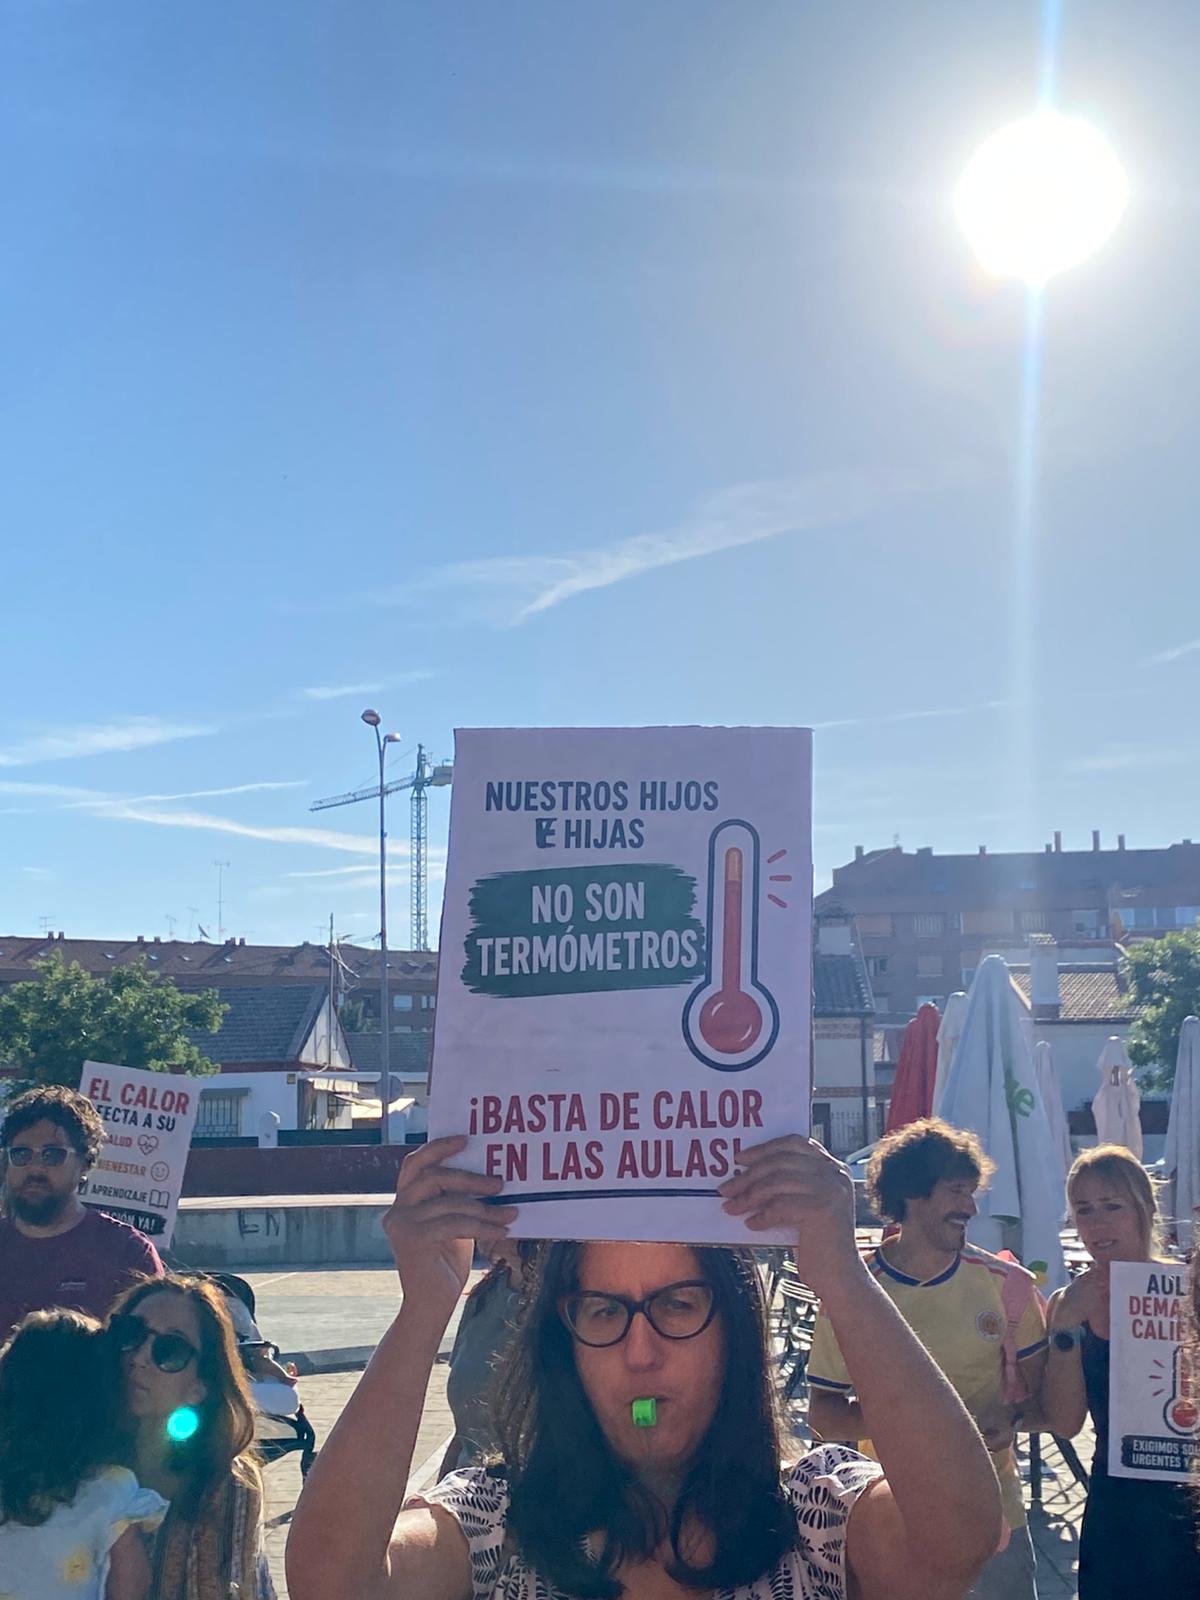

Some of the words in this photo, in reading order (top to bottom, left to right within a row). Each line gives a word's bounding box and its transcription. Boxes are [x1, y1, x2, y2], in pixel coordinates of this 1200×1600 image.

[485, 781, 629, 812] NUESTROS
[640, 780, 720, 811] HIJOS
[564, 818, 645, 849] HIJAS
[531, 884, 574, 924] NO
[585, 882, 645, 922] SON
[476, 925, 698, 976] TERMÓMETROS
[89, 1077, 113, 1102] EL
[121, 1082, 190, 1116] CALOR
[95, 1104, 138, 1126] FECTA
[142, 1112, 152, 1128] A
[156, 1114, 176, 1132] SU
[469, 1093, 587, 1136] ¡BASTA
[600, 1092, 640, 1131] DE
[653, 1089, 763, 1130] CALOR
[486, 1143, 528, 1182] EN
[542, 1140, 604, 1181] LAS
[617, 1137, 742, 1179] AULAS!
[91, 1183, 149, 1203] APRENDIZAJE
[138, 1215, 156, 1230] YA!
[1146, 1274, 1187, 1296] AUL
[1129, 1295, 1182, 1318] DEMA
[1132, 1318, 1187, 1341] CALIE
[1132, 1453, 1181, 1468] URGENTES
[1133, 1440, 1179, 1455] EXIGIMOS
